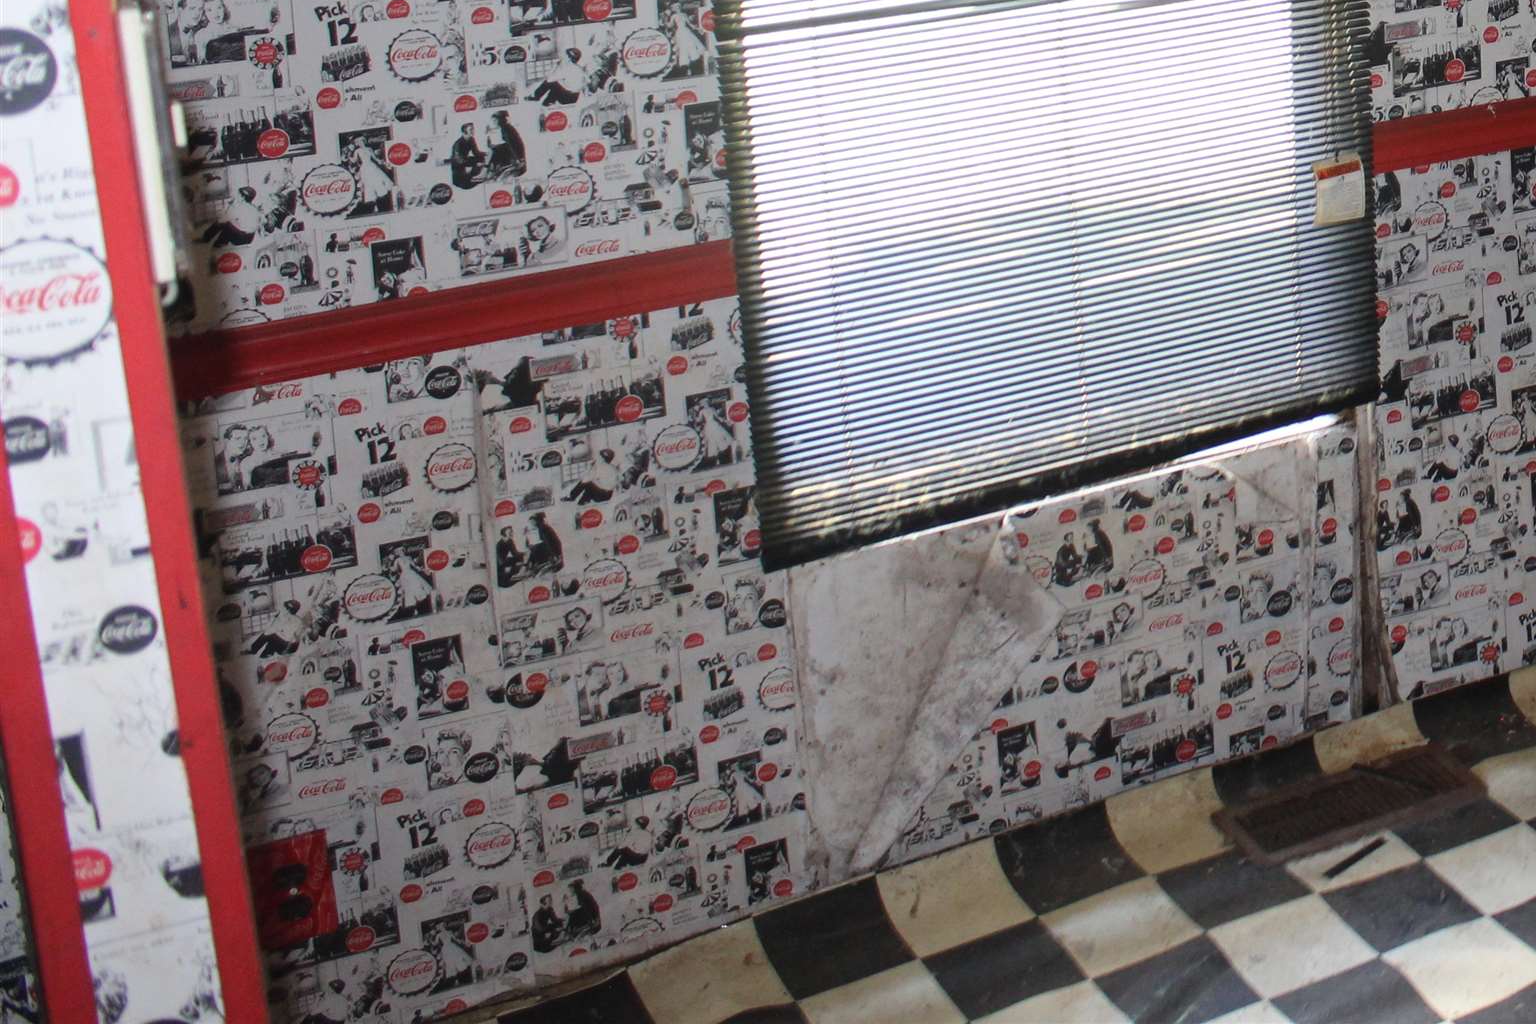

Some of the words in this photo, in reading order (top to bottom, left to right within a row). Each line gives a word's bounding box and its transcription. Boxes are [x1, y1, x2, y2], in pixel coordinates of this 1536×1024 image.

[314, 1, 348, 22] Pick
[328, 19, 358, 46] 12
[391, 48, 438, 64] Coca-Cola
[624, 44, 667, 60] Coca-Cola
[303, 182, 352, 197] Coca-Cola
[576, 240, 621, 258] Coca-Cola
[1497, 291, 1519, 309] Pick
[1505, 304, 1524, 325] 12
[427, 375, 458, 390] Coca-Cola
[355, 423, 387, 442] Pick
[368, 438, 397, 464] 12
[655, 439, 696, 456] Coca-Cola
[427, 459, 473, 476] Coca-Cola
[346, 590, 391, 607] Coca-Cola
[610, 624, 655, 641] Coca-Cola
[1217, 640, 1240, 657] Pick
[698, 653, 726, 672] Pick
[1226, 651, 1245, 673] 12
[709, 668, 734, 691] 12
[272, 726, 312, 741] Coca-Cola
[299, 780, 348, 797] Coca-Cola
[687, 800, 728, 817] Coca-Cola
[397, 810, 428, 830] Pick
[409, 823, 438, 849] 12
[468, 836, 512, 854] Coca-Cola
[391, 963, 432, 982] Coca-Cola
